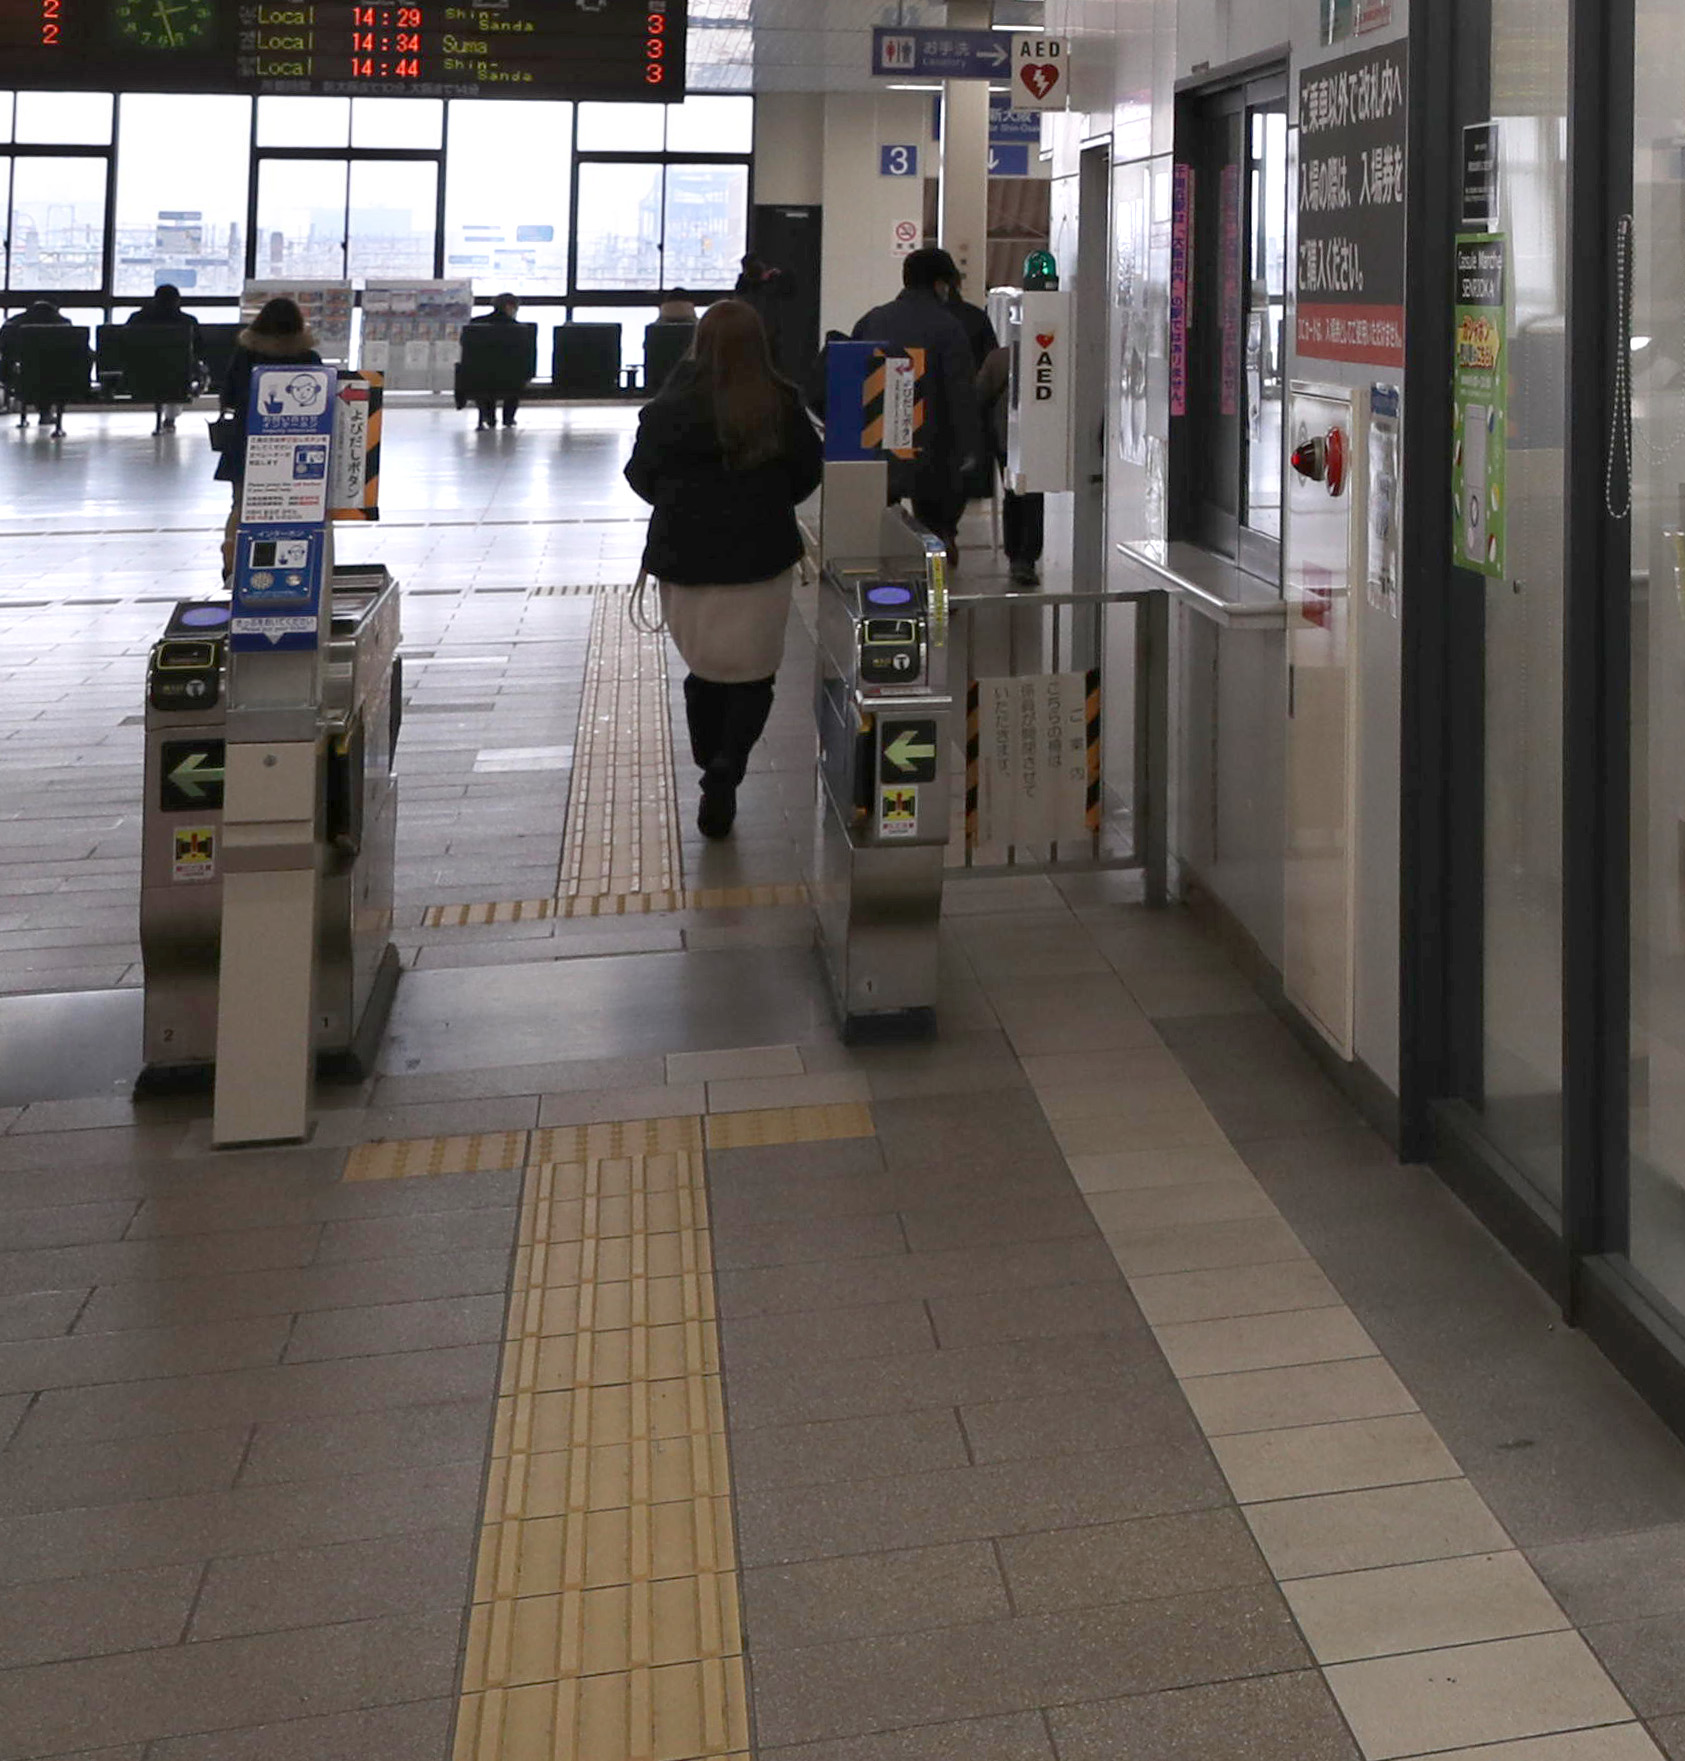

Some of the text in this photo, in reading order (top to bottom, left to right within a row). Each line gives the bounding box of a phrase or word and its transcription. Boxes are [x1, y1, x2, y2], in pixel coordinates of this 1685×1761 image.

[258, 4, 315, 25] Local
[352, 6, 422, 28] 14:29
[647, 14, 665, 34] 3
[478, 20, 535, 32] Sanda
[43, 23, 60, 44] 2
[258, 30, 664, 58] Local 14:34 Suma 3
[1020, 41, 1060, 58] AED
[257, 56, 313, 76] Local
[351, 57, 420, 77] 14:44
[646, 64, 663, 83] 3
[477, 71, 534, 82] Sanda
[1300, 58, 1403, 135] ご乗車以外で改札内へ
[889, 146, 908, 175] 3
[1298, 238, 1364, 292] ご購入ください。
[1035, 351, 1053, 401] AED
[347, 409, 364, 499] よびだしボタン
[163, 1028, 174, 1043] 2
